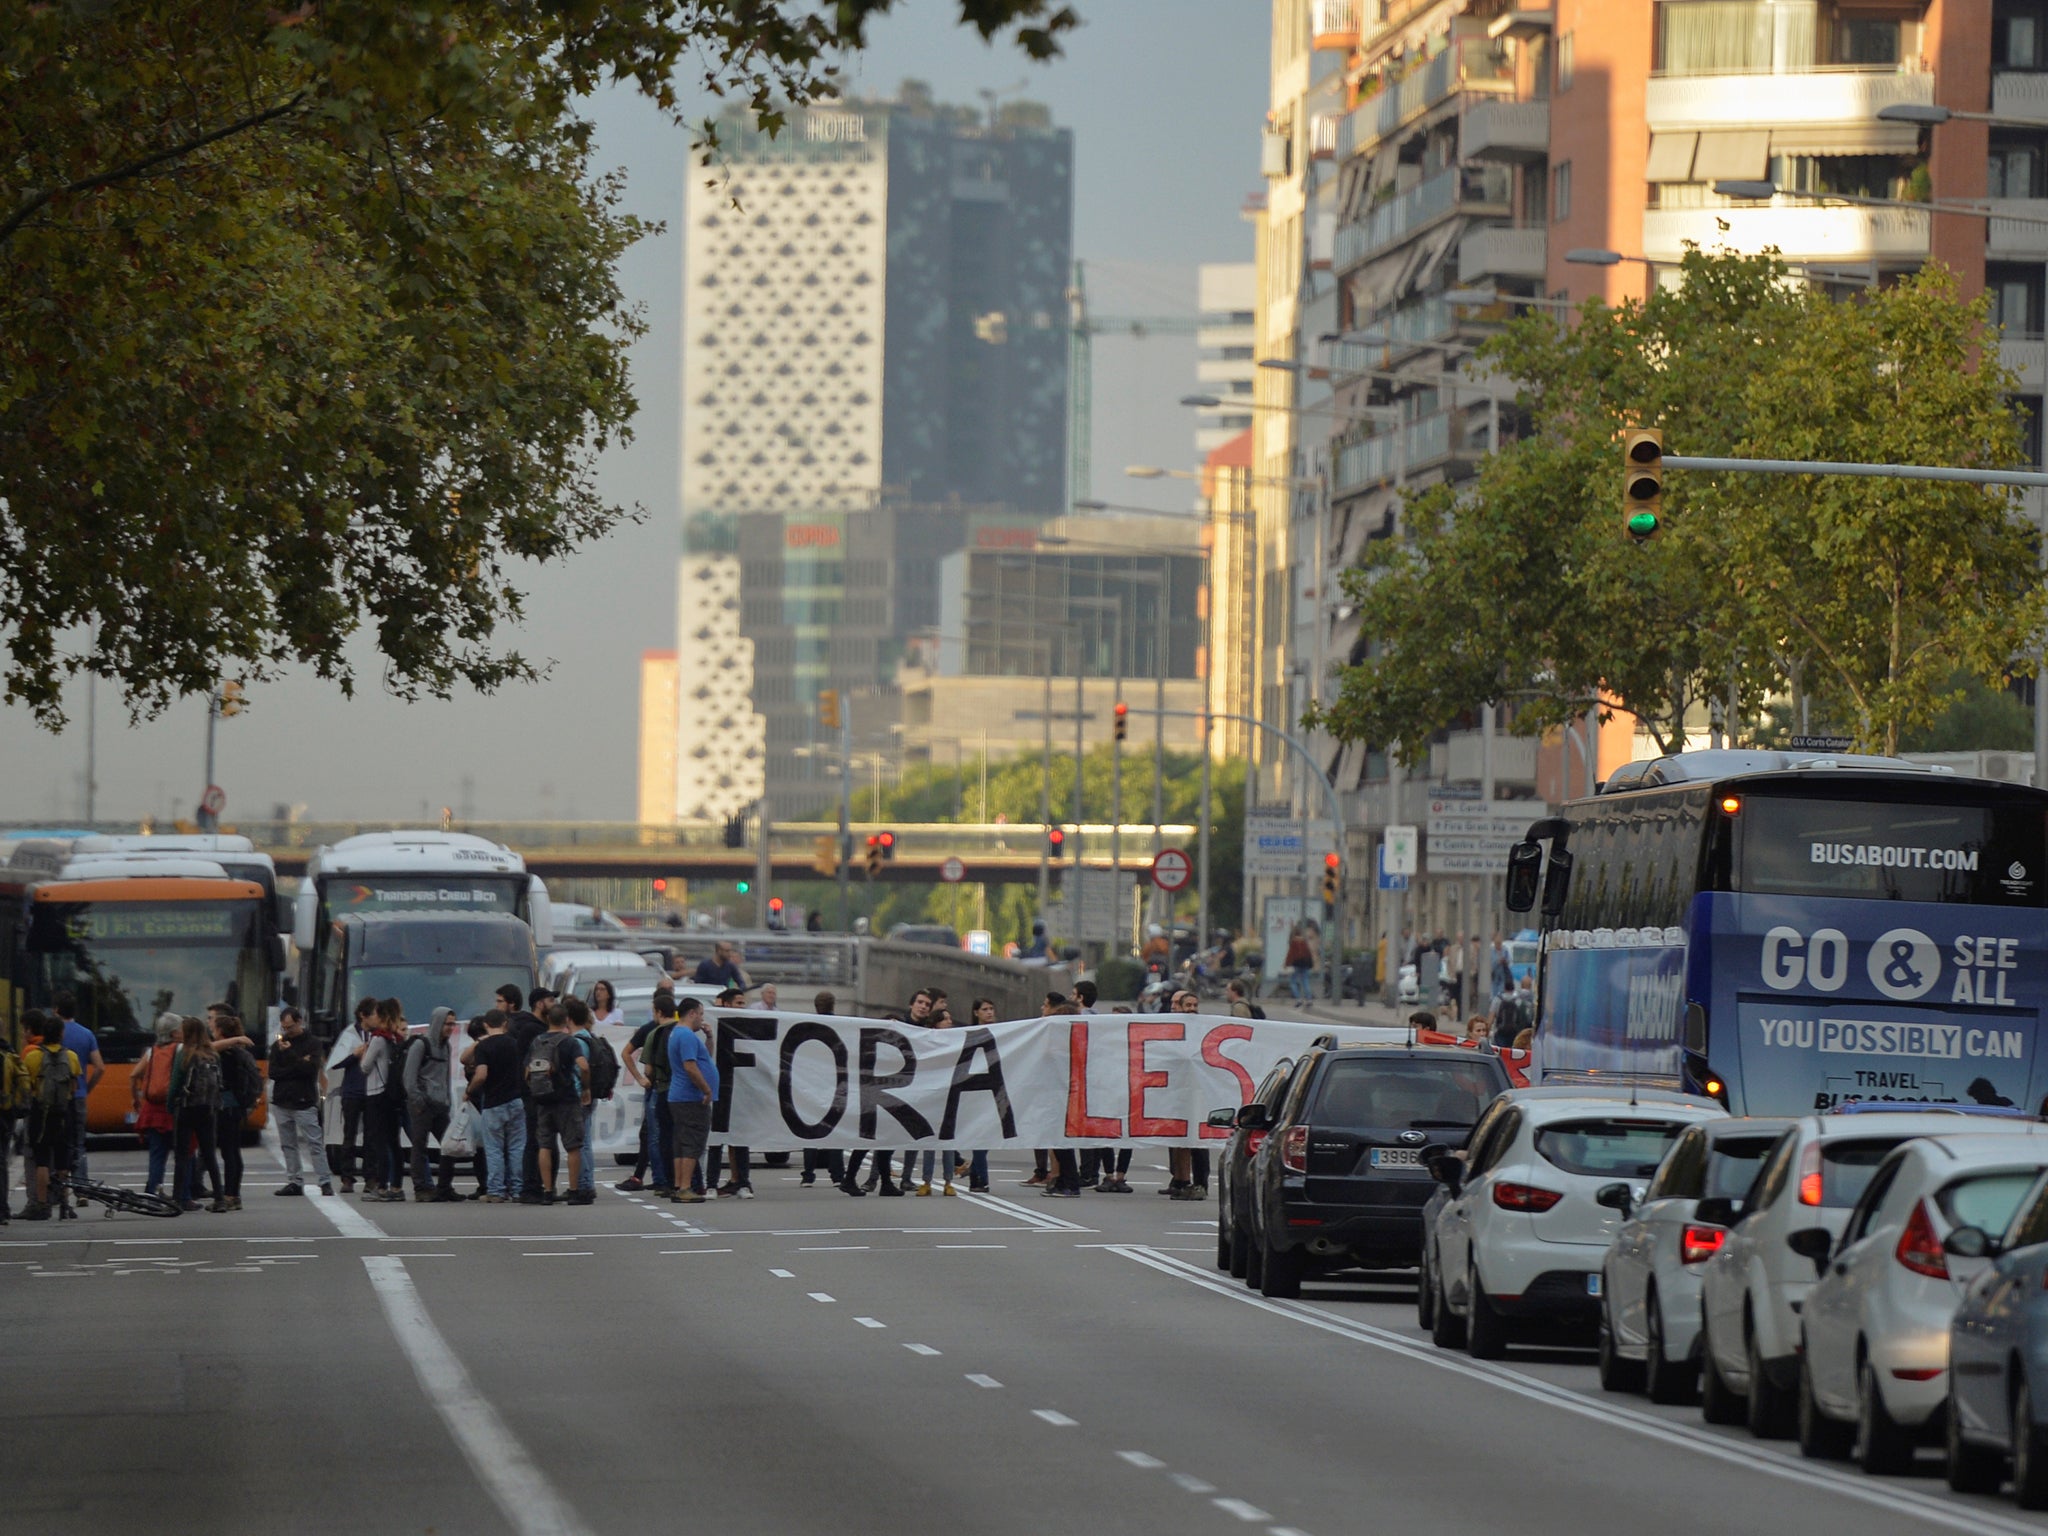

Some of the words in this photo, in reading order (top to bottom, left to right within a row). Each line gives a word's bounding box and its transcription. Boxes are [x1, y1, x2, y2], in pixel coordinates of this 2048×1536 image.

[807, 114, 867, 142] HOTEL
[1811, 843, 1978, 871] BUSABOUT.COM
[1761, 926, 1849, 992] GO
[1884, 939, 1923, 989] &
[1953, 935, 2019, 969] SEE
[1951, 968, 2016, 1006] ALL
[1759, 1019, 1815, 1048] YOU
[1822, 1022, 1958, 1055] POSSIBLY
[1965, 1029, 2022, 1059] CAN
[1064, 1021, 1253, 1139] LES
[1855, 1070, 1919, 1090] TRAVEL
[1381, 1150, 1419, 1164] 3996
